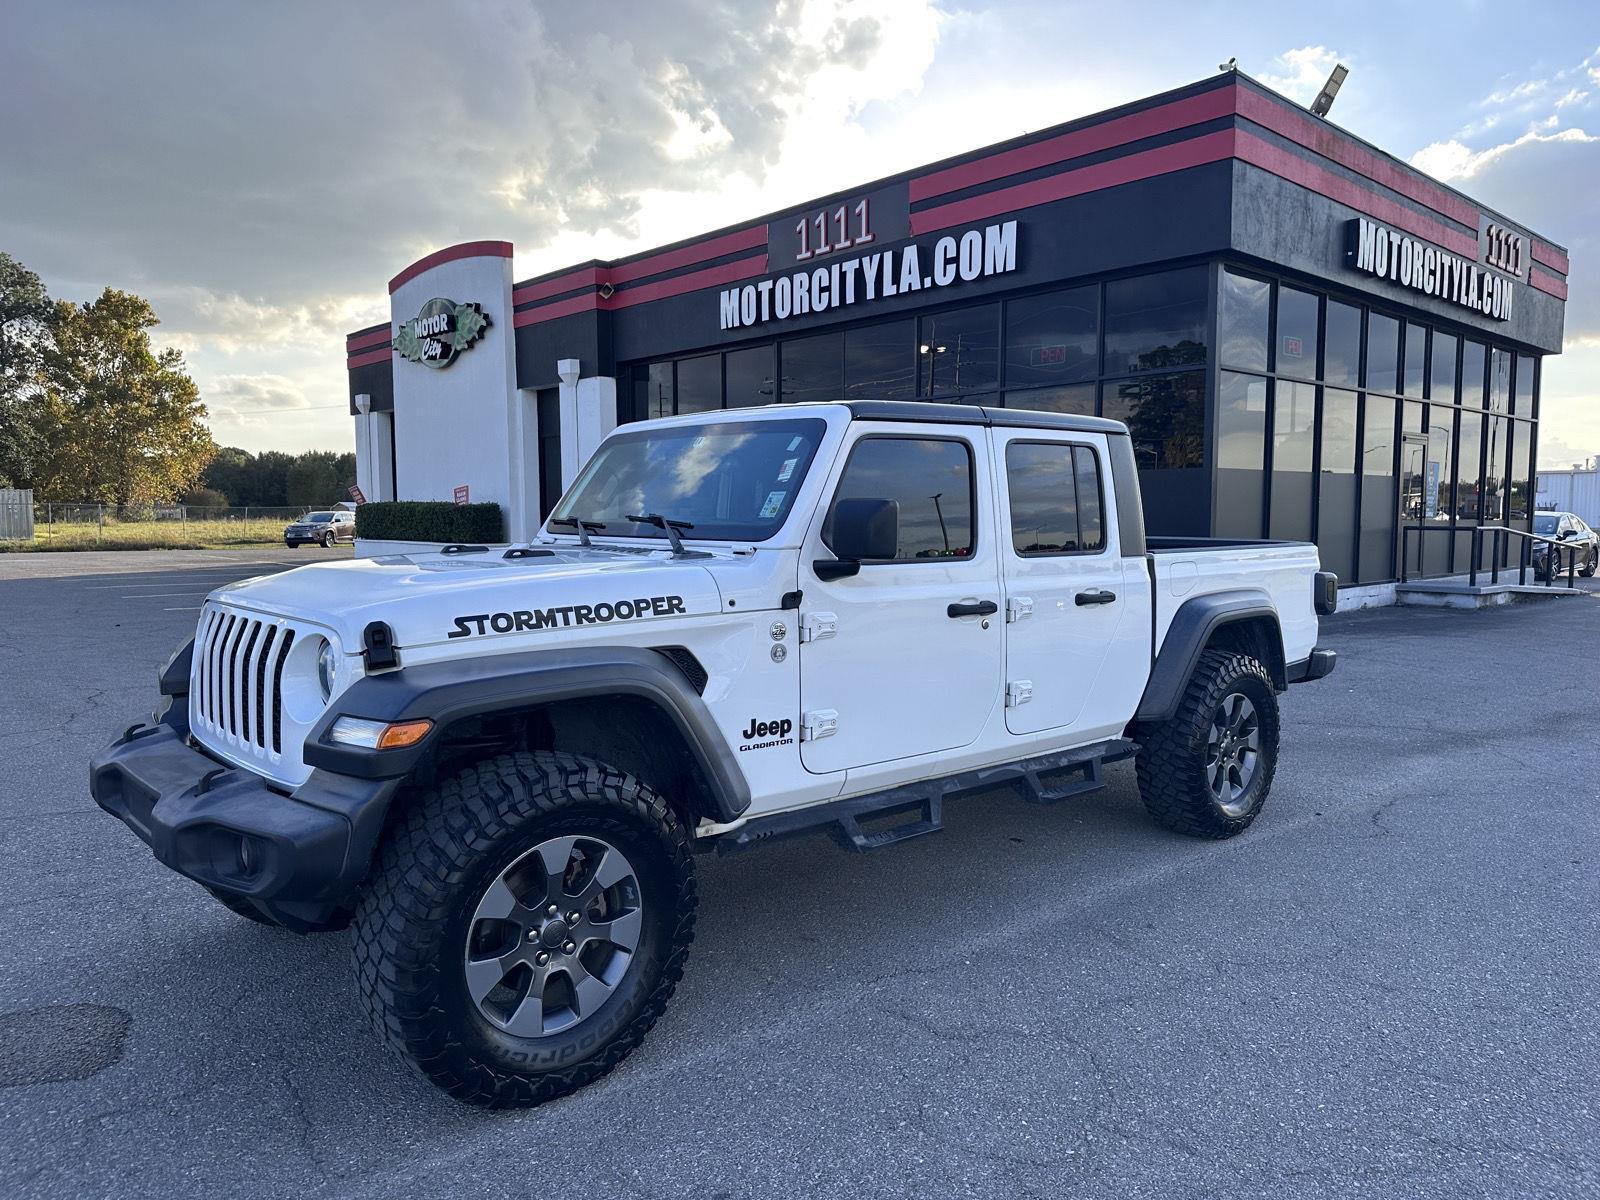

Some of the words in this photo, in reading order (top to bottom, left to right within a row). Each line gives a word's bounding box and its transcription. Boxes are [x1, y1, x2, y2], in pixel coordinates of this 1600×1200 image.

[796, 198, 875, 260] 1111
[1485, 223, 1523, 277] 1111
[720, 220, 1018, 330] MOTORCITYLA.COM
[1356, 217, 1513, 321] MOTORCITYLA.COM
[414, 313, 448, 338] MOTOR
[421, 337, 443, 360] City
[447, 595, 686, 639] STORMTROOPER
[739, 738, 793, 752] GLADIATOR
[742, 718, 792, 739] Jeep
